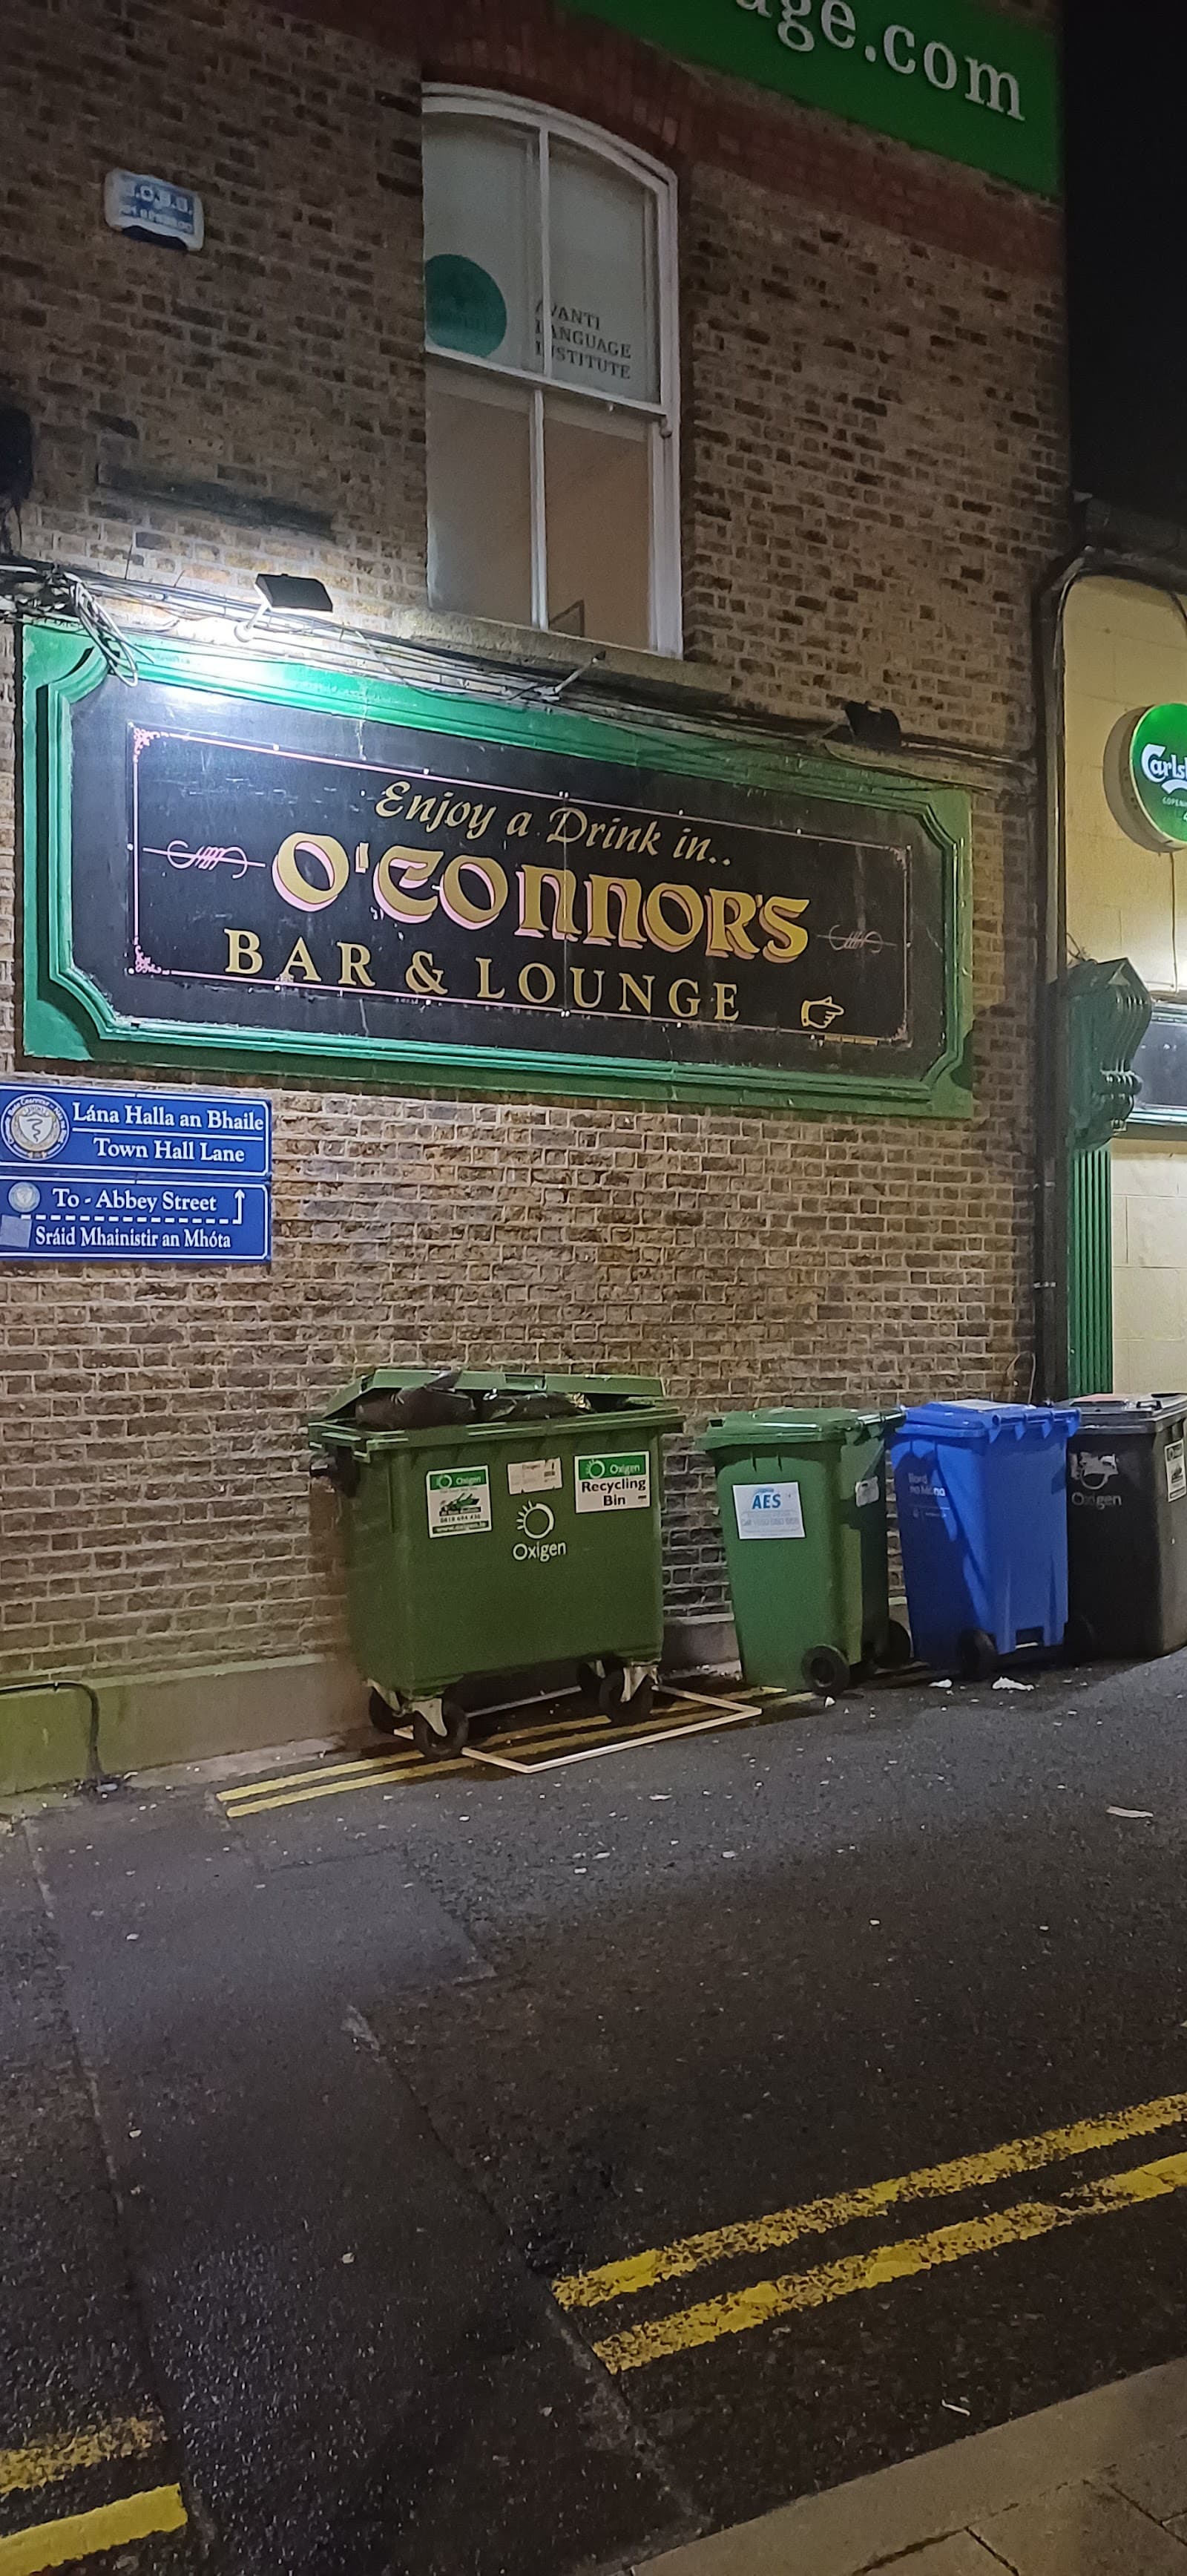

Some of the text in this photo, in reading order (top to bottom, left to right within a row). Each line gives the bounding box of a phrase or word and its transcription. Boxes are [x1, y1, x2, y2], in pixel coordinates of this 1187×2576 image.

[375, 781, 731, 866] Enjoy a Drink in..
[224, 928, 740, 1021] BAR & LOUNGE
[73, 1102, 119, 1123] Lána
[125, 1105, 175, 1127] Halla
[180, 1112, 202, 1128] an
[207, 1110, 264, 1131] Bhaile
[93, 1137, 245, 1163] Town Hall Lane
[53, 1188, 79, 1209] To
[96, 1191, 158, 1213] Abbey
[162, 1192, 217, 1211] Street
[36, 1225, 231, 1248] Sráid Mhainistir an Mhóta
[610, 1463, 640, 1475] Oxigen
[582, 1478, 646, 1494] Recycling
[604, 1494, 626, 1506] Bin
[752, 1494, 781, 1510] AES
[513, 1541, 566, 1562] Oxigen
